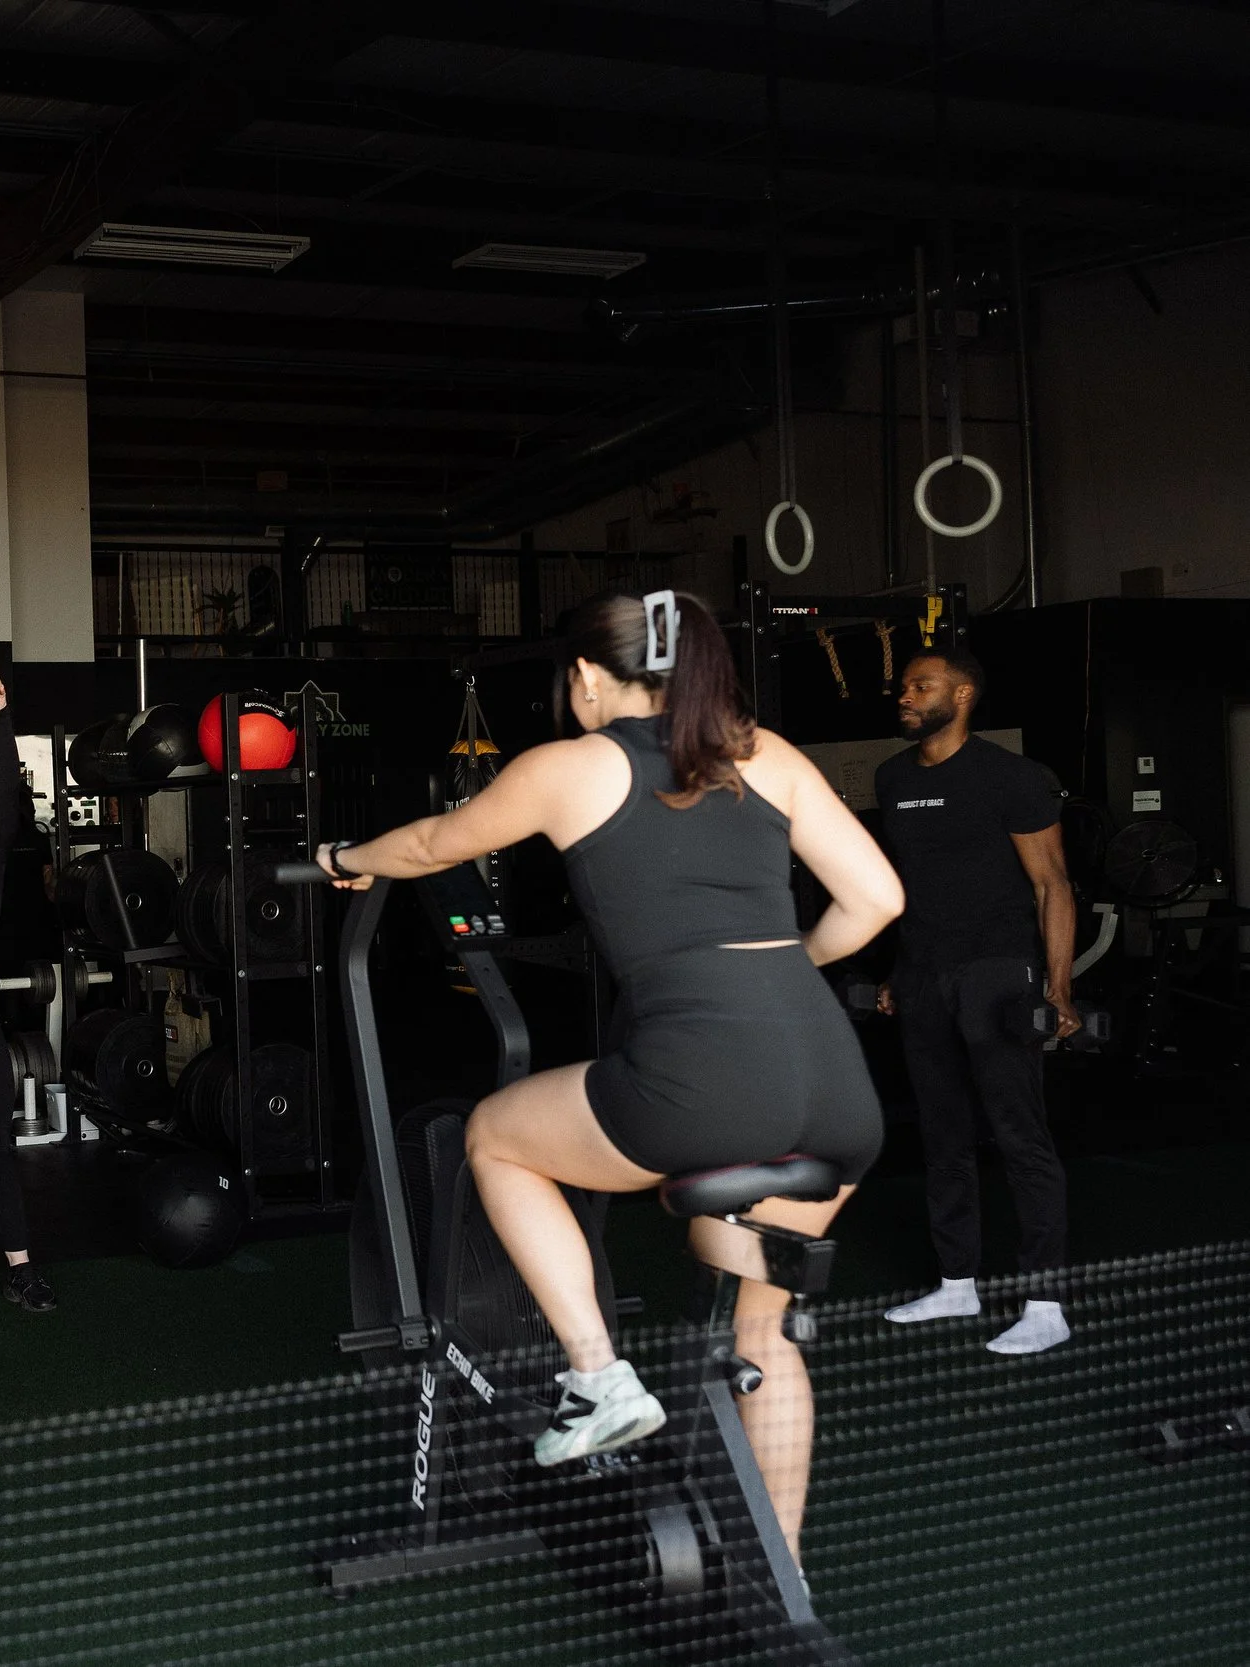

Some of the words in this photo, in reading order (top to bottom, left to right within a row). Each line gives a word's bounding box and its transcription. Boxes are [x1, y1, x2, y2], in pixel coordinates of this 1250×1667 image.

[775, 607, 811, 615] TITAN
[331, 723, 370, 737] ZONE
[896, 800, 919, 809] PRODUCT
[218, 1175, 229, 1190] 10
[446, 1342, 472, 1379] ECHO
[470, 1369, 496, 1405] BIKE
[412, 1366, 436, 1511] ROGUE
